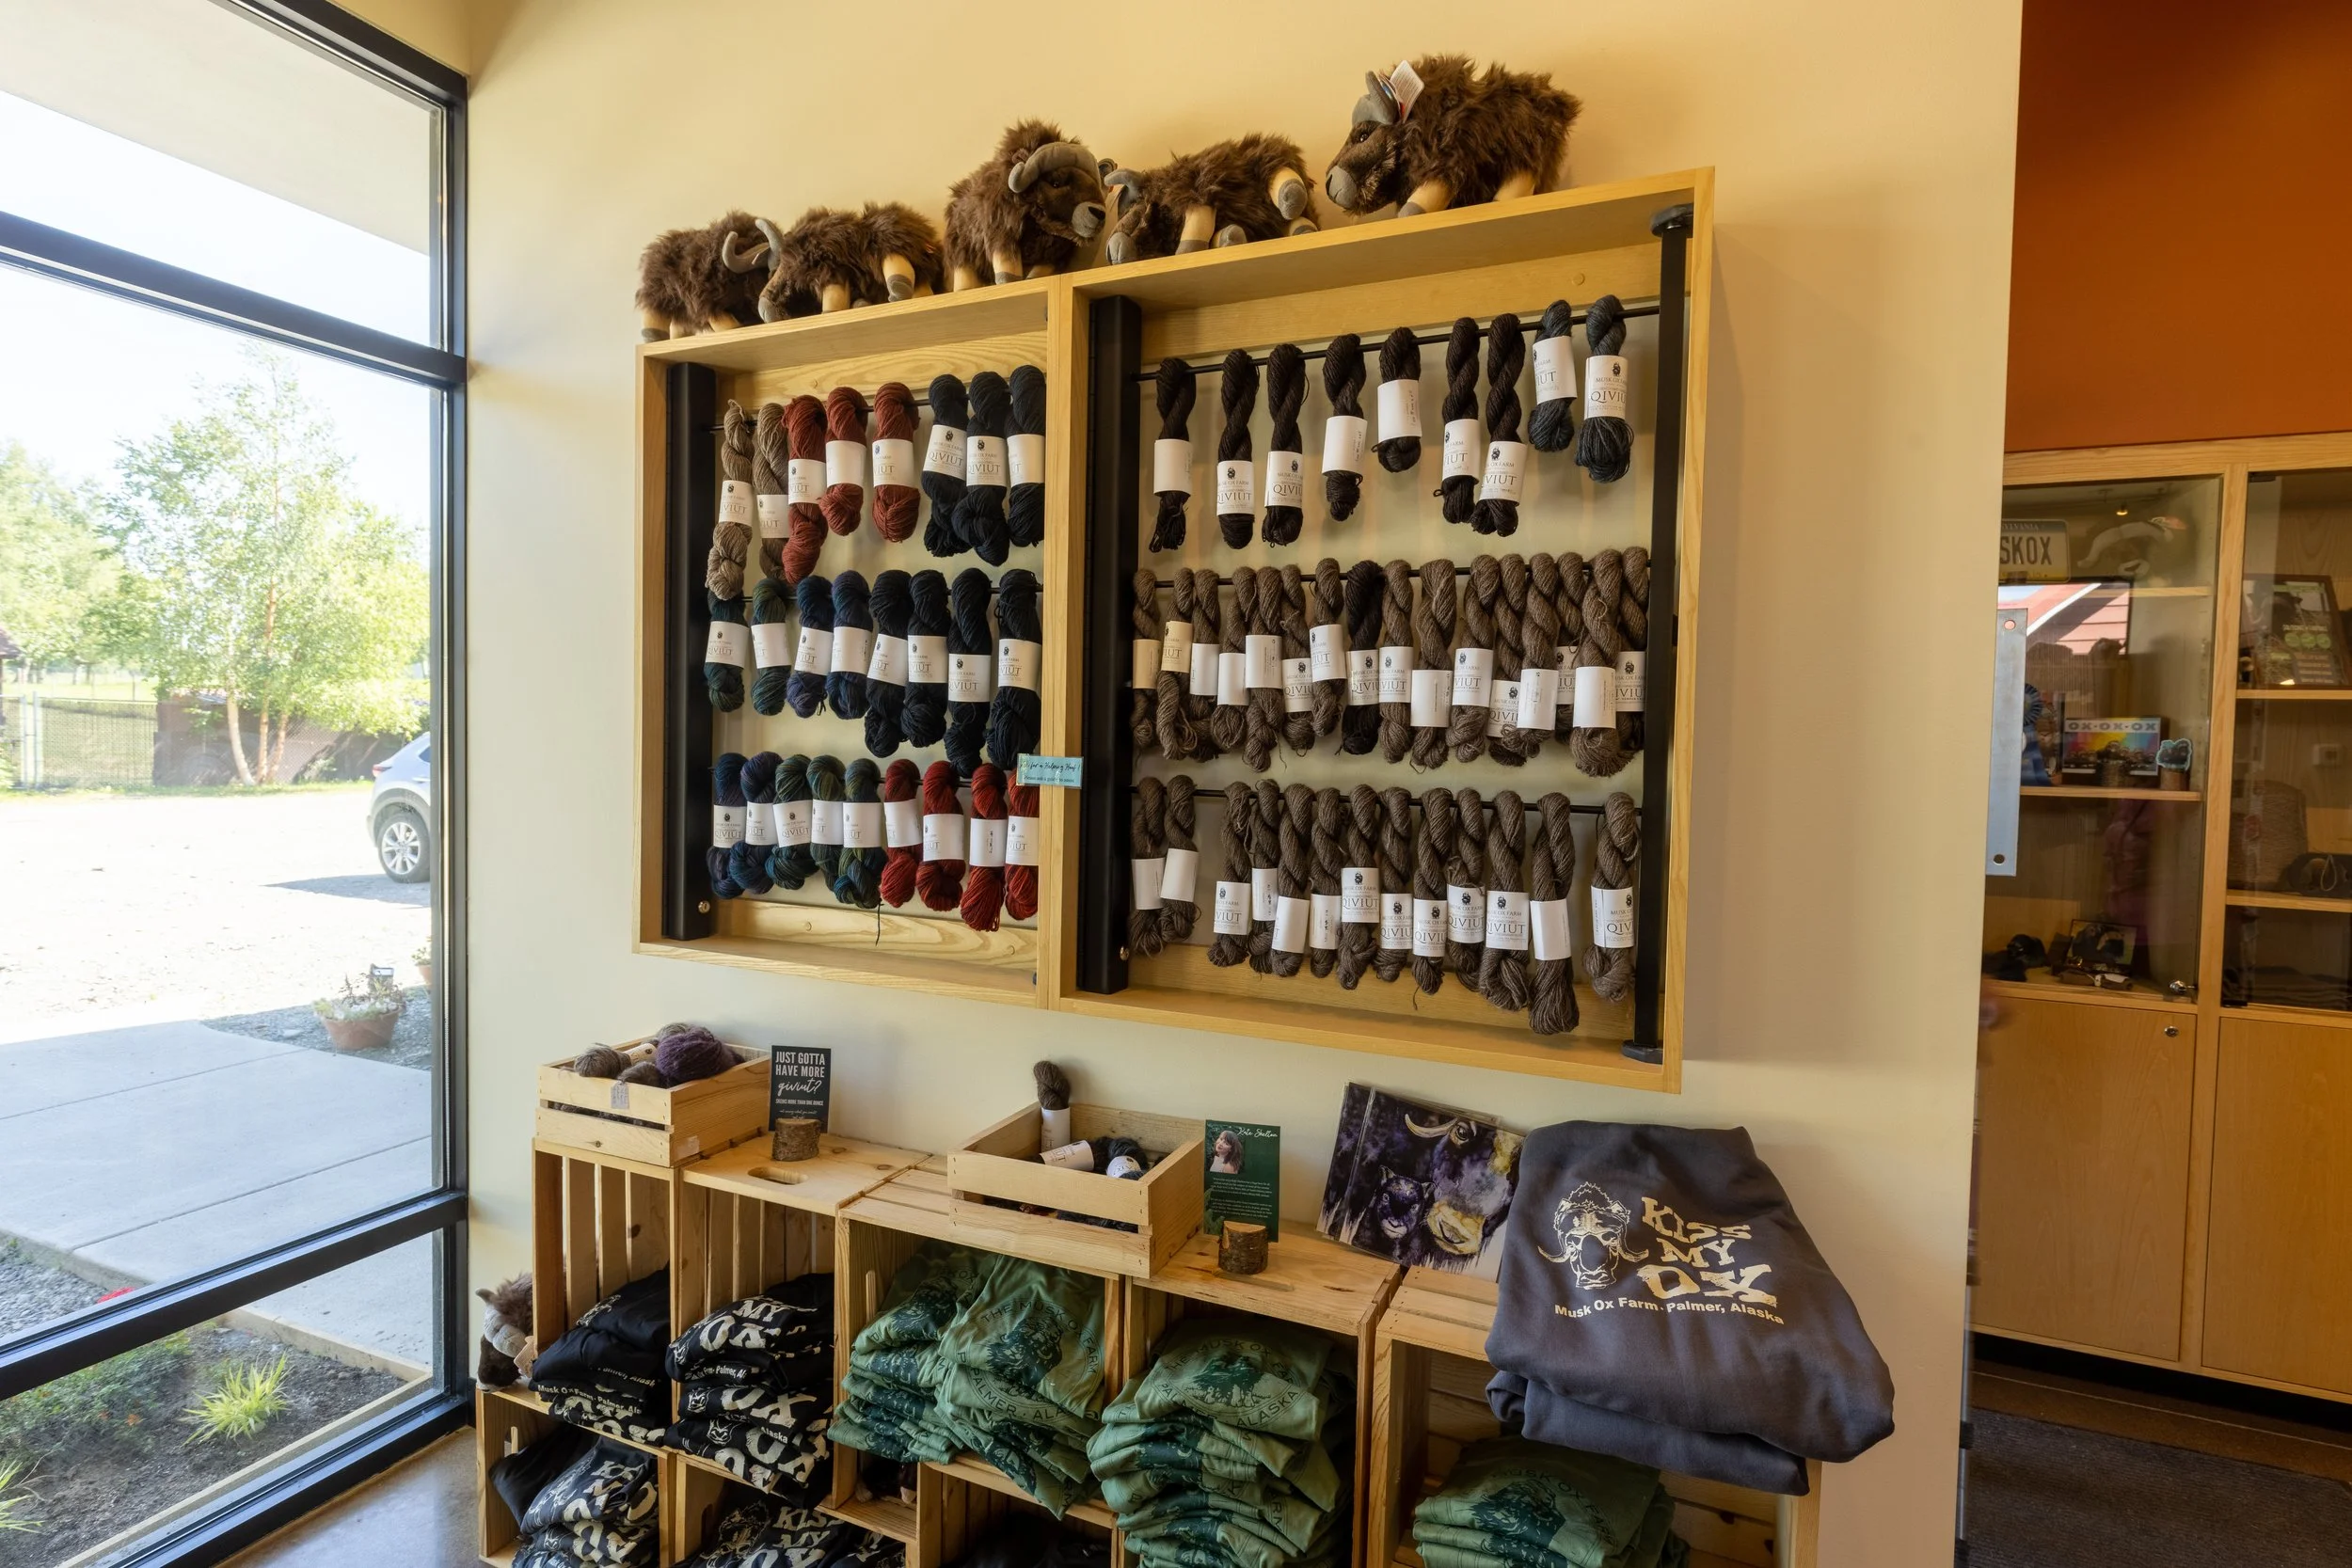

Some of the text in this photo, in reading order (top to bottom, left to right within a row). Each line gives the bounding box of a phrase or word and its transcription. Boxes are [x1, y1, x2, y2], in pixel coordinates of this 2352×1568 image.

[2000, 535, 2053, 565] SKOX
[1490, 710, 1518, 722] QIVI
[775, 1051, 825, 1066] JUST GOTTA
[775, 1064, 825, 1078] HAVE MORE
[1641, 1196, 1753, 1243] KISS
[1657, 1238, 1737, 1269] MY
[1637, 1263, 1778, 1308] OX
[732, 1300, 789, 1323] MY
[1554, 1297, 1785, 1325] Musk Ox Farm Palmer, Alaska
[981, 1303, 1012, 1323] THE
[1019, 1300, 1066, 1322] MUSK
[1083, 1337, 1101, 1374] FARM
[1196, 1338, 1245, 1354] MUSK
[1250, 1343, 1271, 1357] OX
[537, 1385, 560, 1394] Musk
[575, 1388, 595, 1401] Farm
[971, 1367, 1017, 1417] PALMER
[1236, 1390, 1299, 1428] ALASKA
[761, 1426, 788, 1444] Alaska
